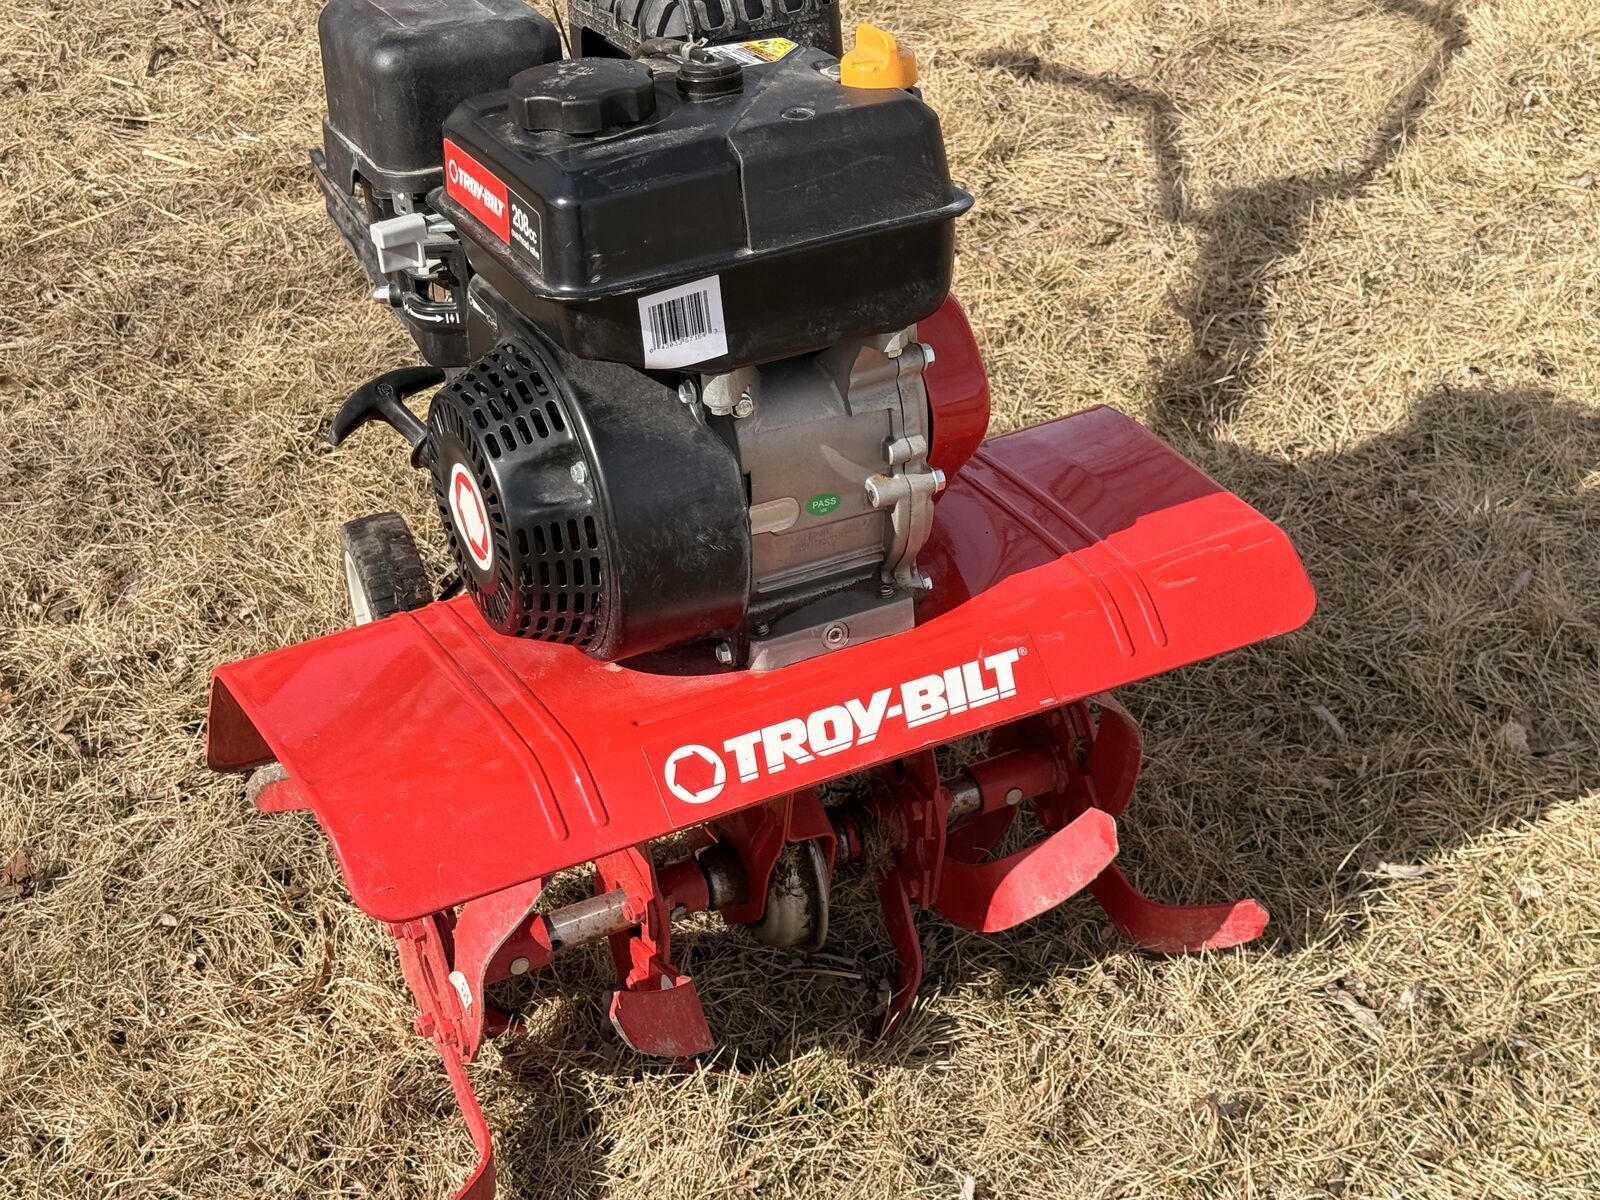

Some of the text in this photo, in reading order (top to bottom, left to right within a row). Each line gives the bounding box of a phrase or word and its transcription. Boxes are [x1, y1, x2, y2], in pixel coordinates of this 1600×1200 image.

[458, 167, 505, 219] TROY-BILT
[511, 203, 538, 245] 208cc
[812, 496, 837, 510] PASS
[723, 647, 1020, 784] TROY-BILT
